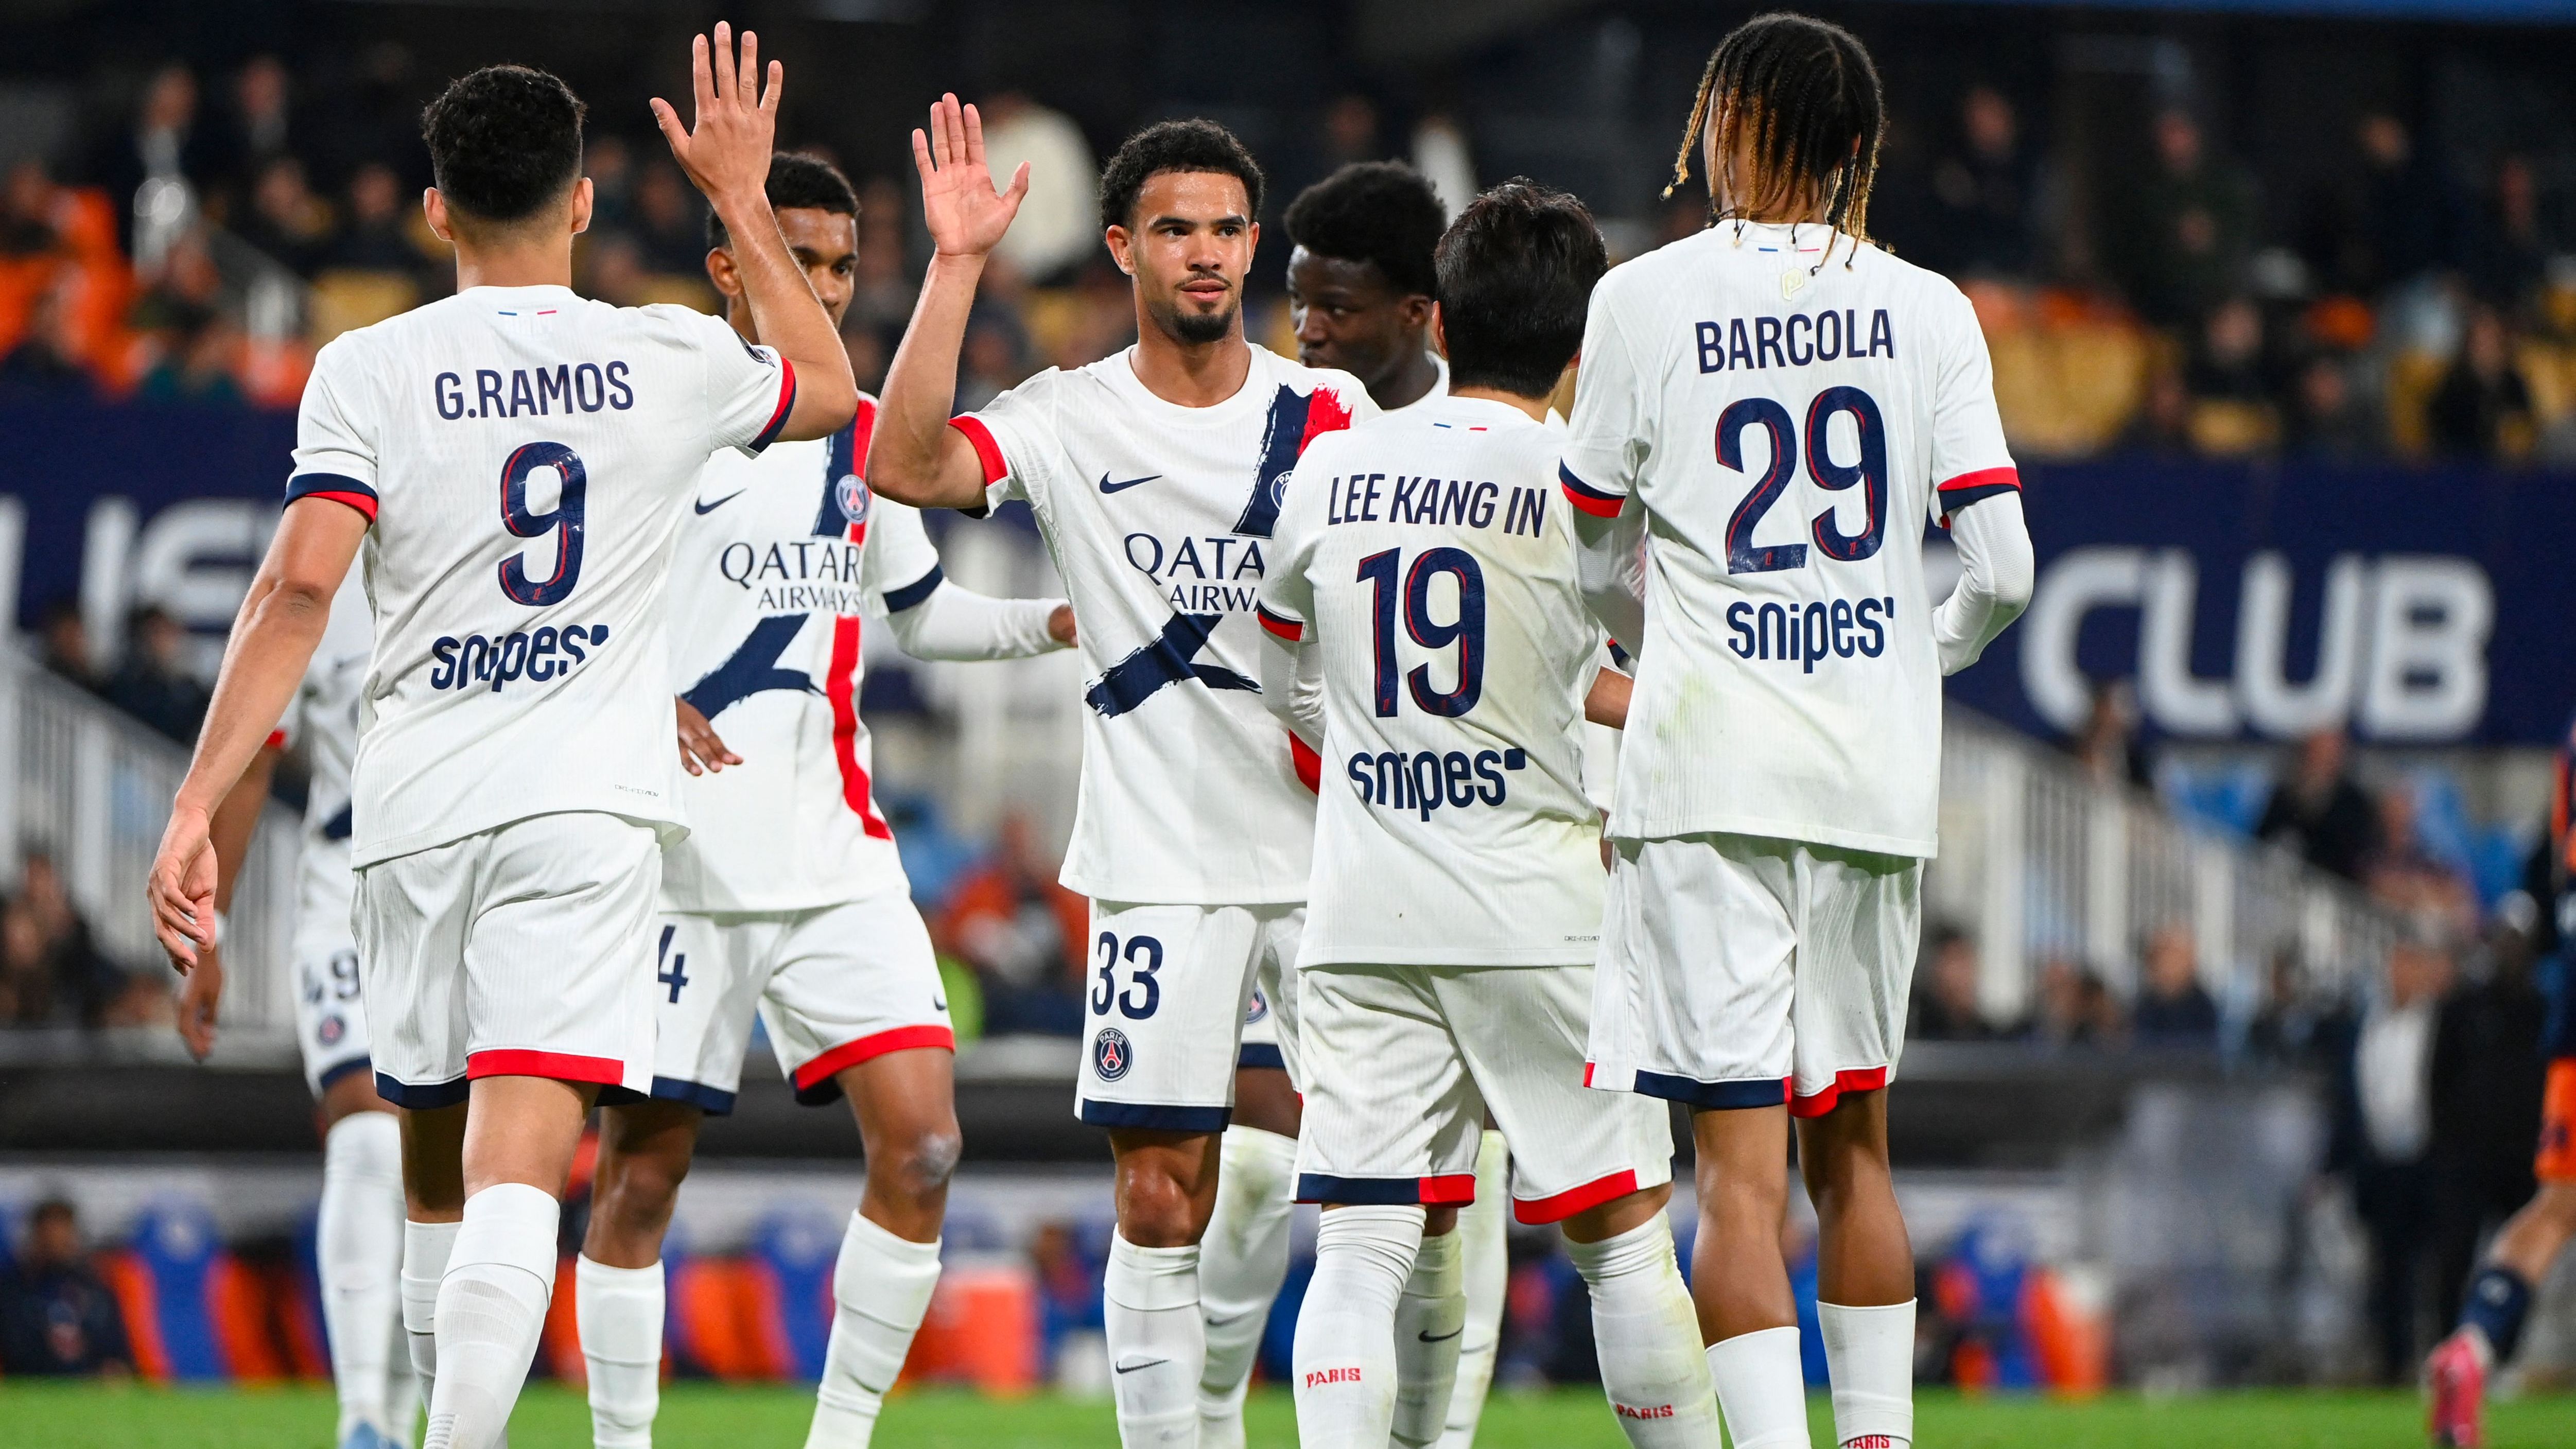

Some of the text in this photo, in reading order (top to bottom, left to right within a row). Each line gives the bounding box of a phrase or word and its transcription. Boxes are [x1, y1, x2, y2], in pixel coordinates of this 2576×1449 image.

[1696, 309, 1893, 374] BARCOLA
[435, 361, 633, 420] G.RAMOS
[1328, 474, 1547, 538] LEE KANG IN
[1715, 386, 1888, 575] 29
[498, 442, 587, 606] 9
[721, 542, 860, 590] QATAR
[1124, 533, 1265, 586] QATA
[758, 586, 861, 615] AIRWAYS
[1170, 584, 1259, 612] AIRW
[431, 624, 589, 693] snipes
[1356, 547, 1486, 718] 19
[1726, 599, 1885, 674] snipes
[2018, 546, 2496, 741] CLUB
[1348, 750, 1507, 822] snipes
[1092, 931, 1163, 1020] 33
[1099, 1032, 1124, 1045] PARIS
[1306, 1367, 1362, 1388] PARIS
[1616, 1403, 1674, 1420] PARIS
